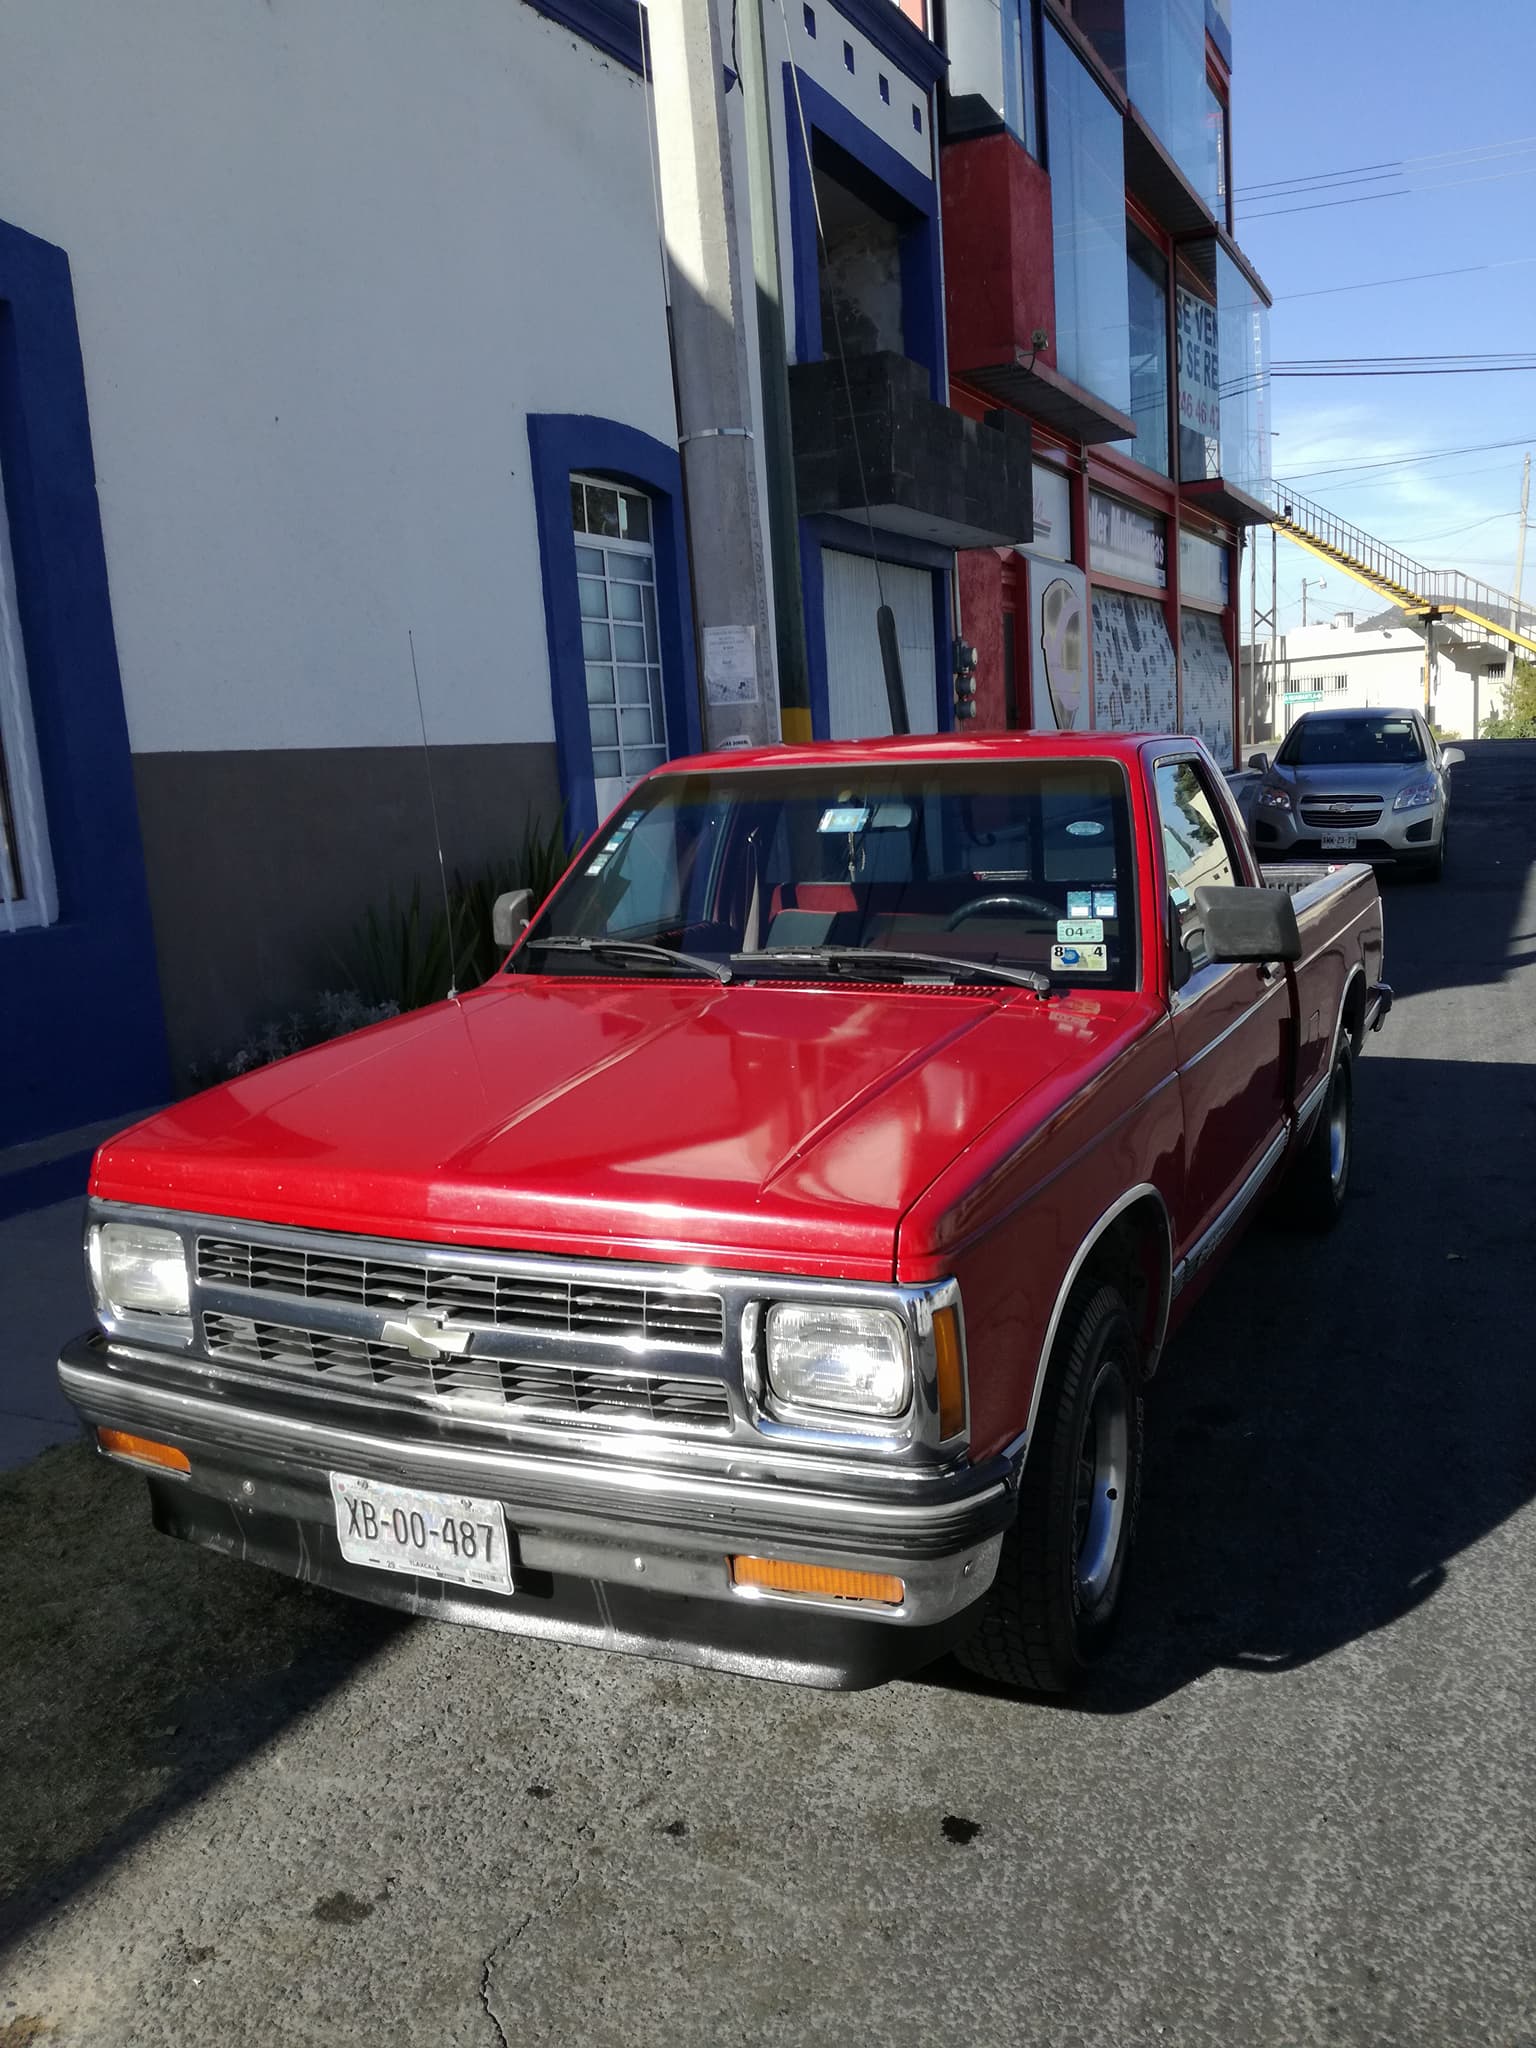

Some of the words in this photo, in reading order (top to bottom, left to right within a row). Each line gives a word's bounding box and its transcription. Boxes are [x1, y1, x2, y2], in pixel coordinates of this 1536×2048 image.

[1186, 339, 1201, 383] SE
[1065, 927, 1083, 937] 04
[1054, 946, 1064, 957] 8
[1093, 946, 1103, 957] 4
[344, 1497, 493, 1563] XB-00-487
